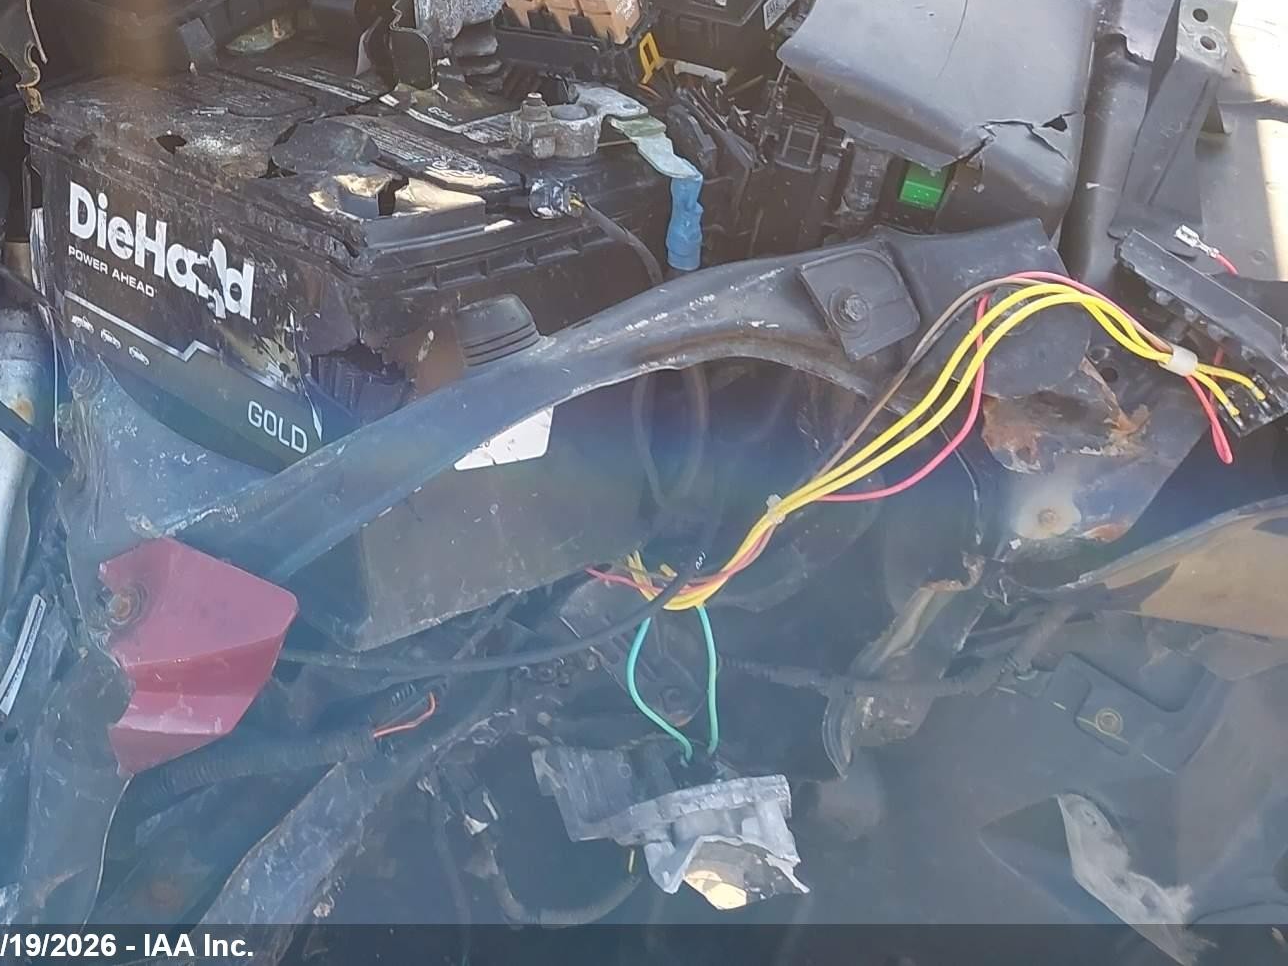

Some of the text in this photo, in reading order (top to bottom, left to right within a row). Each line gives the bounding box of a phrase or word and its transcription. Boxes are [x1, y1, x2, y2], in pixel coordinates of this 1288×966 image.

[68, 245, 156, 299] POWER AHEAD
[246, 399, 309, 455] GOLD
